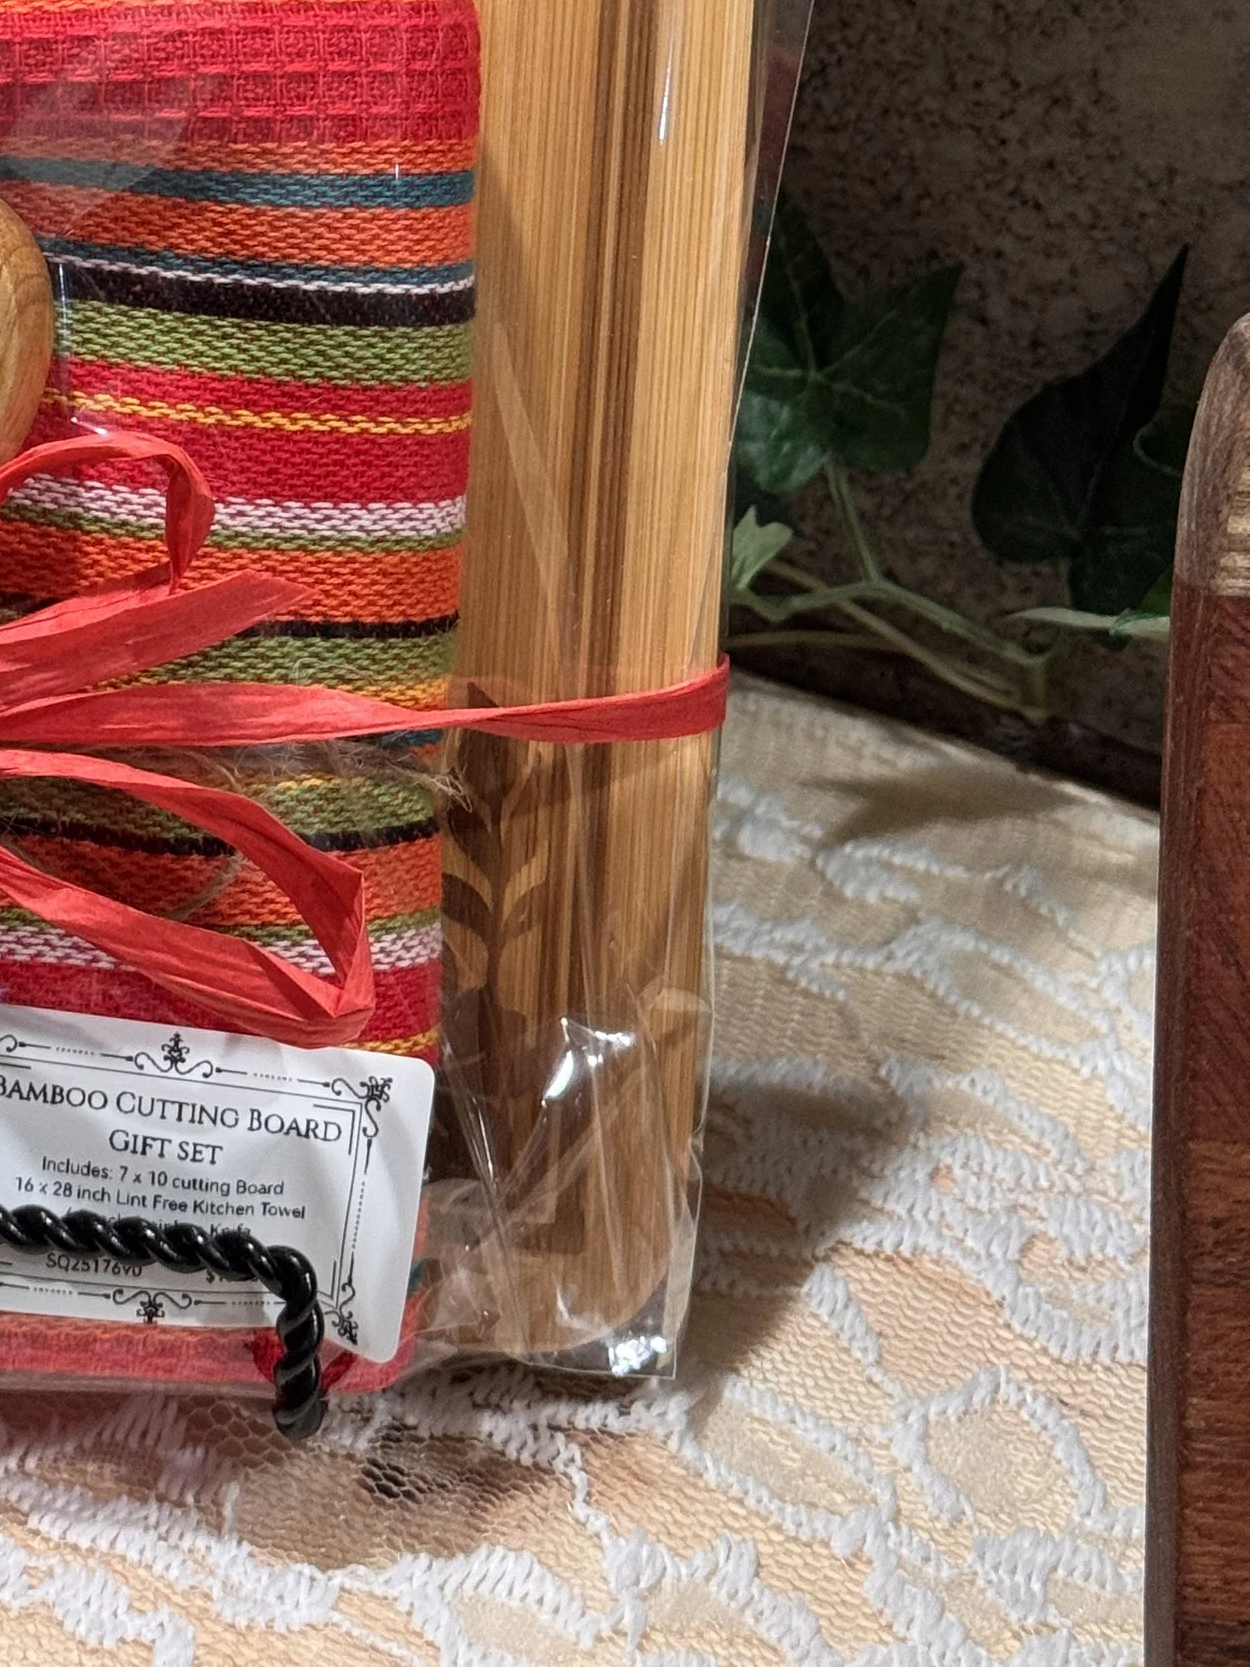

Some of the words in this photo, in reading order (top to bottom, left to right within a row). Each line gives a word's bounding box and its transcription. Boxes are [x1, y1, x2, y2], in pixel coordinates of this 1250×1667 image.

[116, 1091, 240, 1128] CUTTING
[247, 1108, 342, 1142] BOARD
[109, 1129, 172, 1159] GIFT
[177, 1140, 223, 1165] SET
[41, 1155, 113, 1180] Includes:
[119, 1165, 129, 1182] 7
[132, 1173, 142, 1184] x
[148, 1170, 168, 1187] 10
[172, 1177, 231, 1197] cutting
[236, 1179, 285, 1195] Board
[16, 1176, 34, 1193] 16
[53, 1180, 73, 1197] 28
[77, 1184, 111, 1203] inch
[116, 1188, 148, 1208] Lint
[152, 1194, 188, 1213] Free
[193, 1198, 255, 1217] Kitchen
[261, 1201, 306, 1220] Towel
